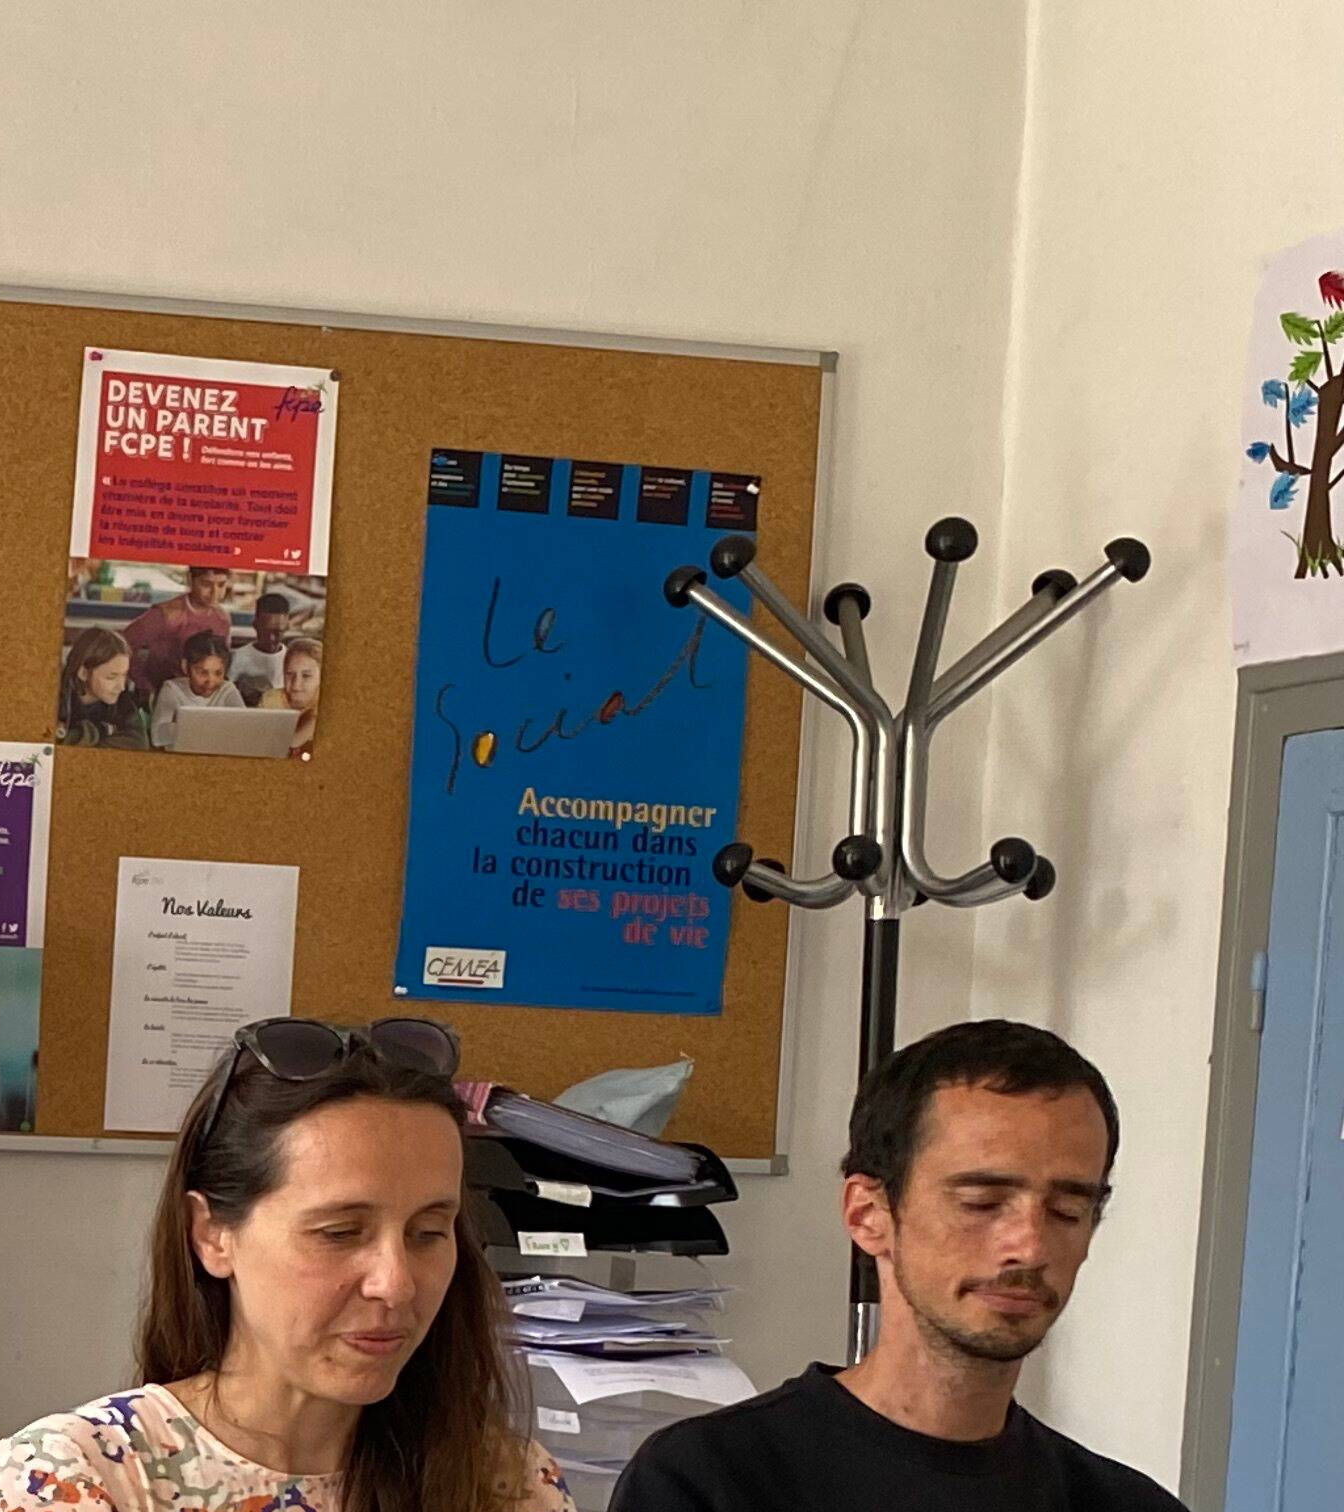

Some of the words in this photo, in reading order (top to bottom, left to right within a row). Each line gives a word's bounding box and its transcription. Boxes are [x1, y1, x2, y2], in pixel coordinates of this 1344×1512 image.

[108, 379, 239, 413] DEVENEZ
[106, 405, 148, 431] UN
[156, 409, 269, 442] PARENT
[104, 430, 175, 460] FCPE
[182, 436, 191, 461] !
[518, 787, 717, 832] Accompagner
[516, 820, 619, 850] chacun
[632, 826, 698, 857] dans
[472, 847, 497, 875] la
[511, 854, 691, 887] construction
[162, 896, 194, 916] Nos
[196, 898, 253, 919] Valeurs
[512, 880, 546, 908] de
[556, 888, 601, 913] ses
[610, 889, 711, 922] projets
[623, 917, 657, 946] de
[669, 918, 710, 949] vie
